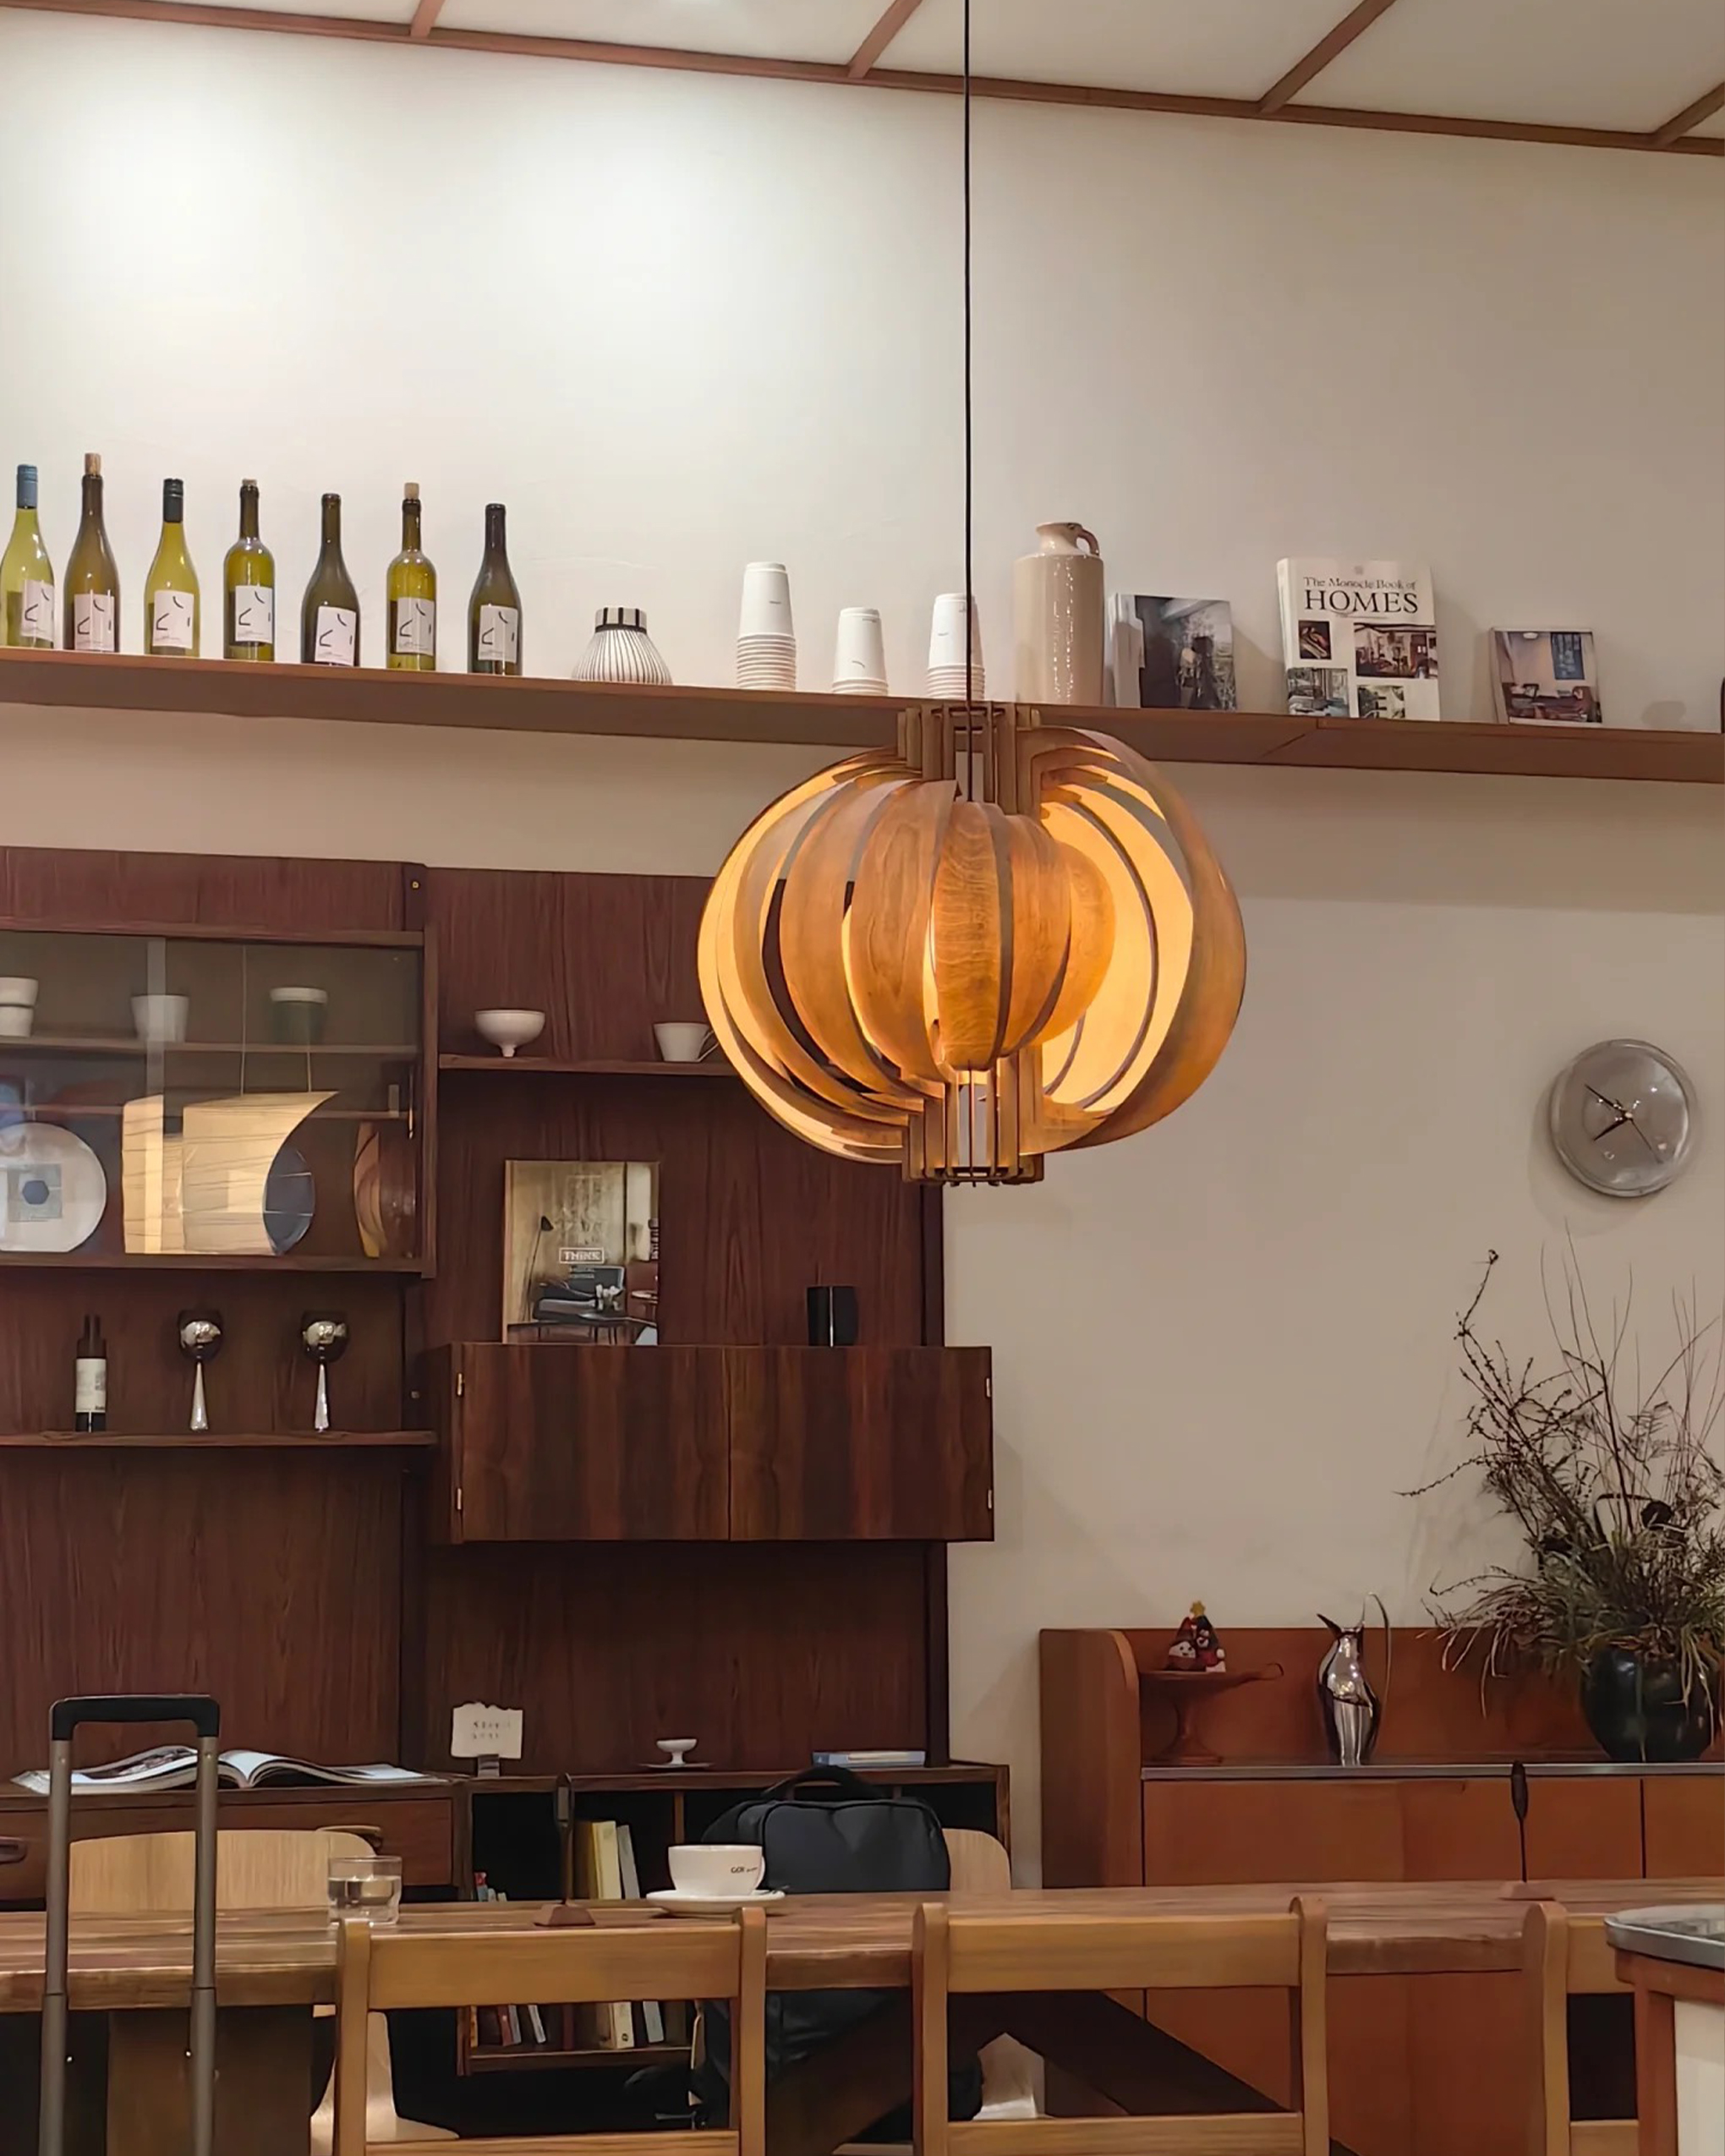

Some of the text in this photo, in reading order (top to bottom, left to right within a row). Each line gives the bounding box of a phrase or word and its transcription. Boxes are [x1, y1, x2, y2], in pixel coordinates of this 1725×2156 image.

[1303, 577, 1417, 590] The Monocle Book of
[1305, 589, 1419, 614] HOMES
